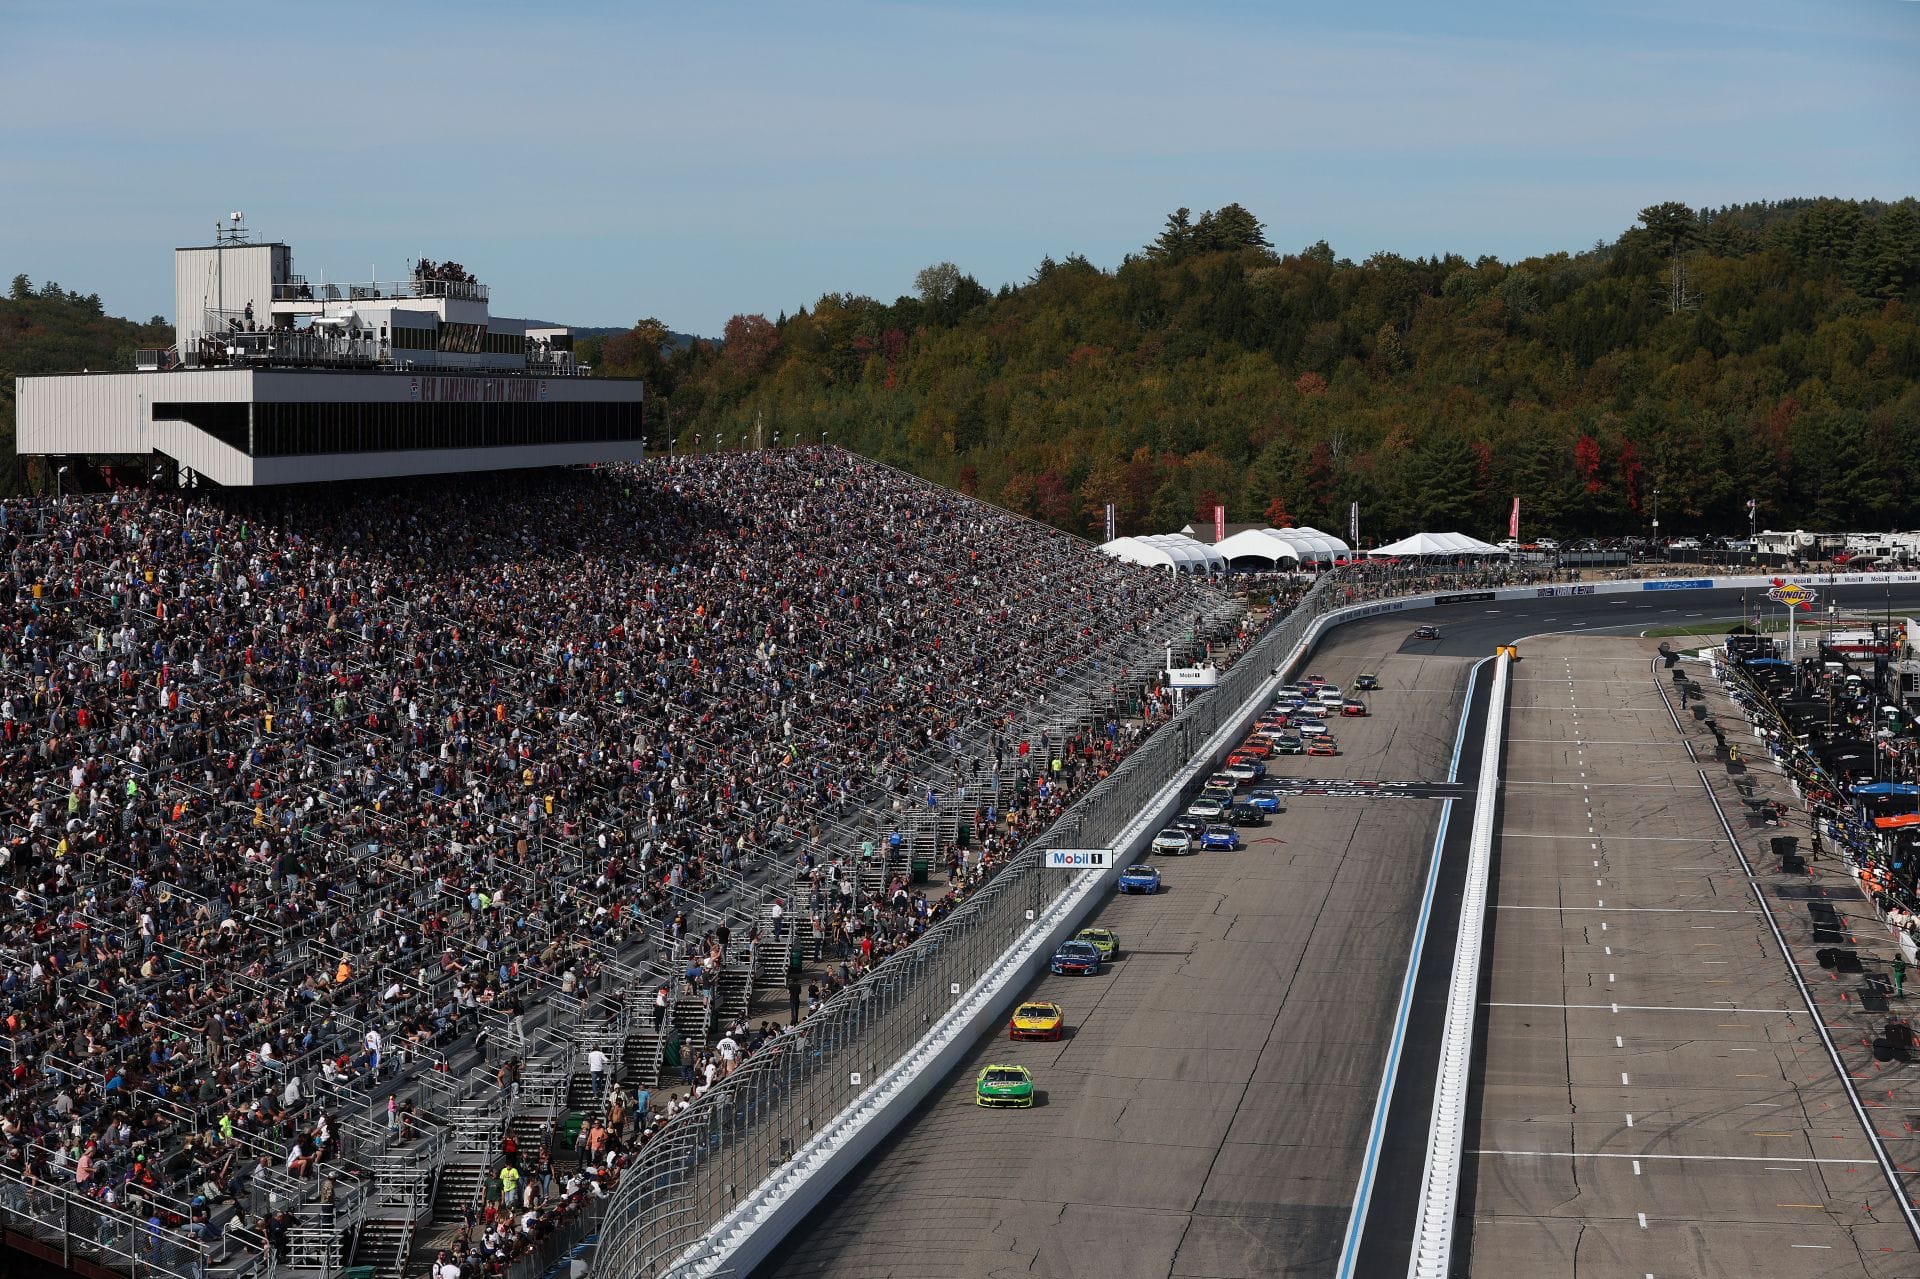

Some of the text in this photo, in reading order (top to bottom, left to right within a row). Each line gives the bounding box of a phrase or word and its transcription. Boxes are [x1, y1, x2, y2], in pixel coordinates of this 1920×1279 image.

[440, 377, 479, 401] HAMPSHIRE
[1772, 590, 1812, 600] SUNOCO
[1053, 853, 1089, 864] Mobil
